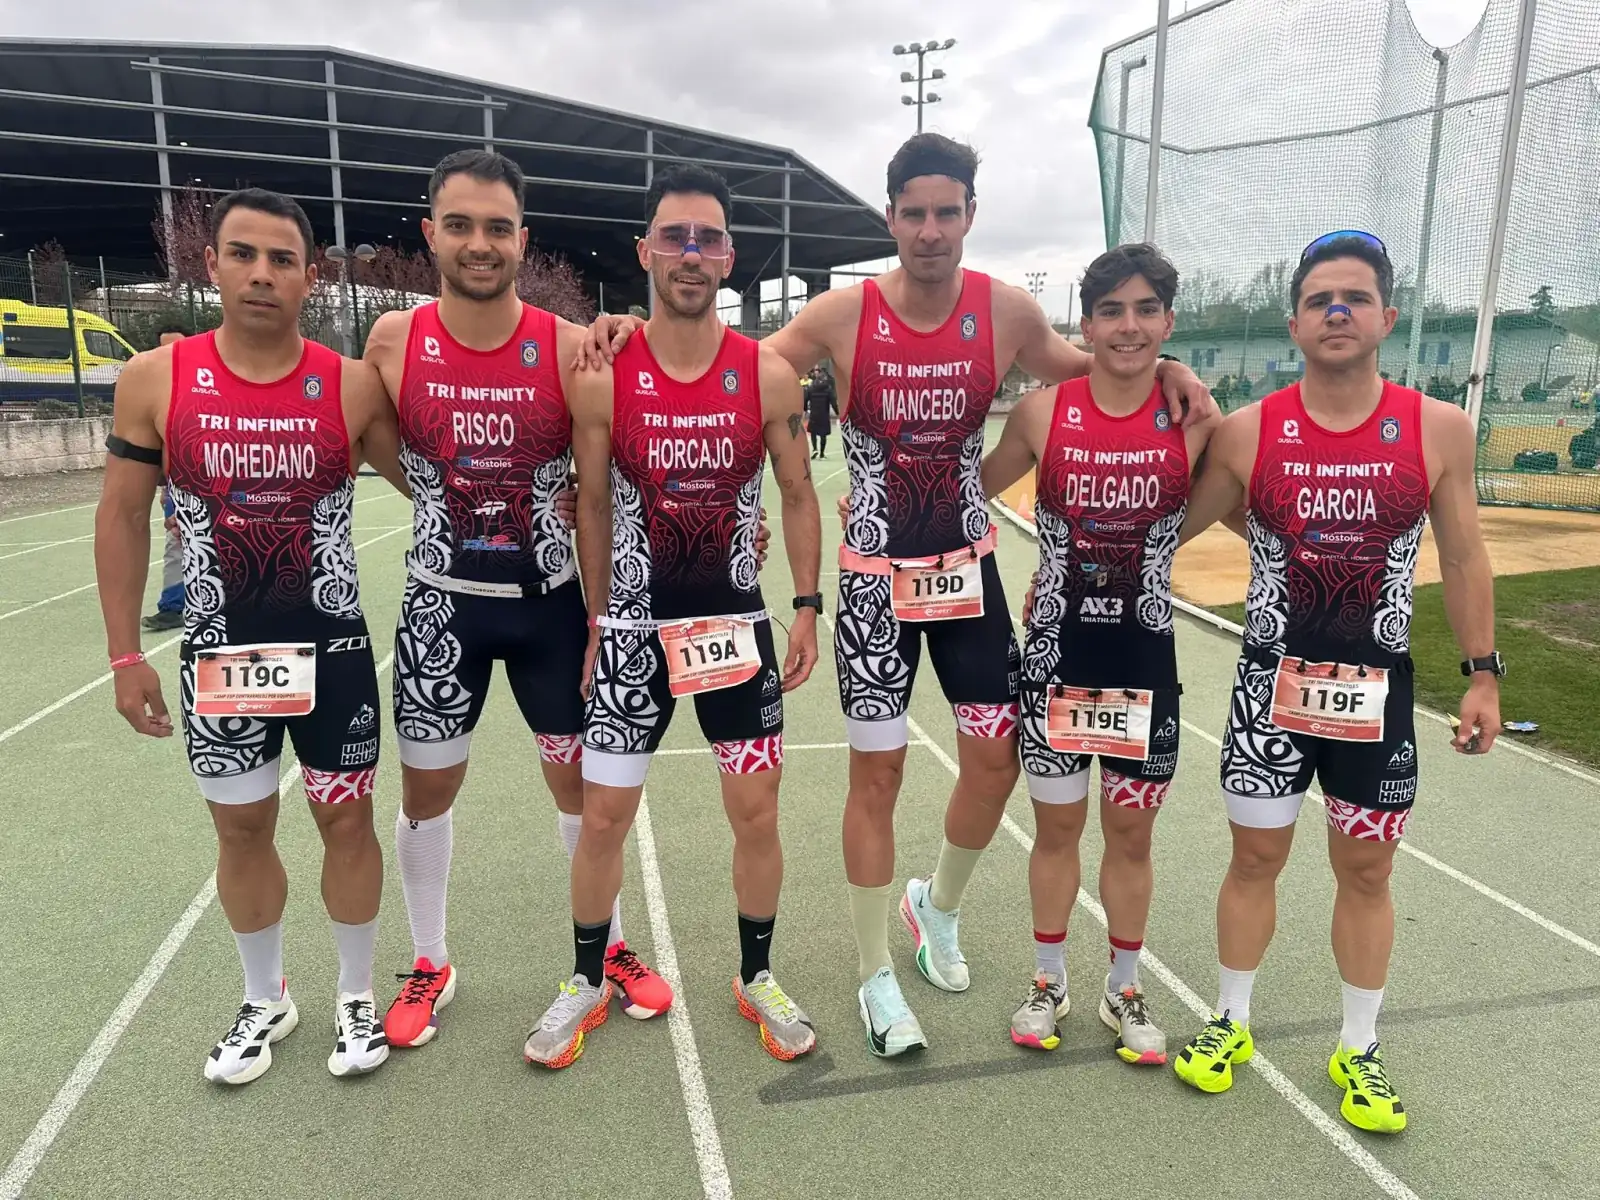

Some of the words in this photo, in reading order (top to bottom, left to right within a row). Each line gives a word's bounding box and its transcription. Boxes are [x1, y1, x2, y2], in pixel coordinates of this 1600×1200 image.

[877, 360, 902, 377] TRI
[907, 360, 972, 378] INFINITY
[426, 382, 456, 399] TRI
[461, 386, 536, 402] INFINITY
[882, 388, 966, 421] MANCEBO
[198, 414, 230, 430] TRI
[237, 417, 318, 432] INFINITY
[452, 411, 515, 447] RISCO
[642, 412, 668, 428] TRI
[672, 412, 736, 428] INFINITY
[204, 442, 316, 480] MOHEDANO
[648, 437, 734, 469] HORCAJO
[1063, 446, 1089, 462] TRI
[1094, 448, 1168, 465] INFINITY
[1282, 462, 1310, 476] TRI
[1316, 462, 1394, 477] INFINITY
[1065, 473, 1160, 509] DELGADO
[1296, 487, 1377, 521] GARCIA
[912, 574, 964, 596] 119D
[1080, 596, 1124, 616] AX3
[680, 639, 740, 667] 119A
[221, 666, 290, 688] 119C
[1300, 686, 1365, 713] 119F
[350, 711, 374, 727] ACP
[1069, 708, 1127, 732] 119E
[1154, 724, 1176, 738] ACP
[340, 749, 376, 765] HAUS
[1390, 748, 1414, 763] ACP
[1378, 789, 1414, 803] HAUS
